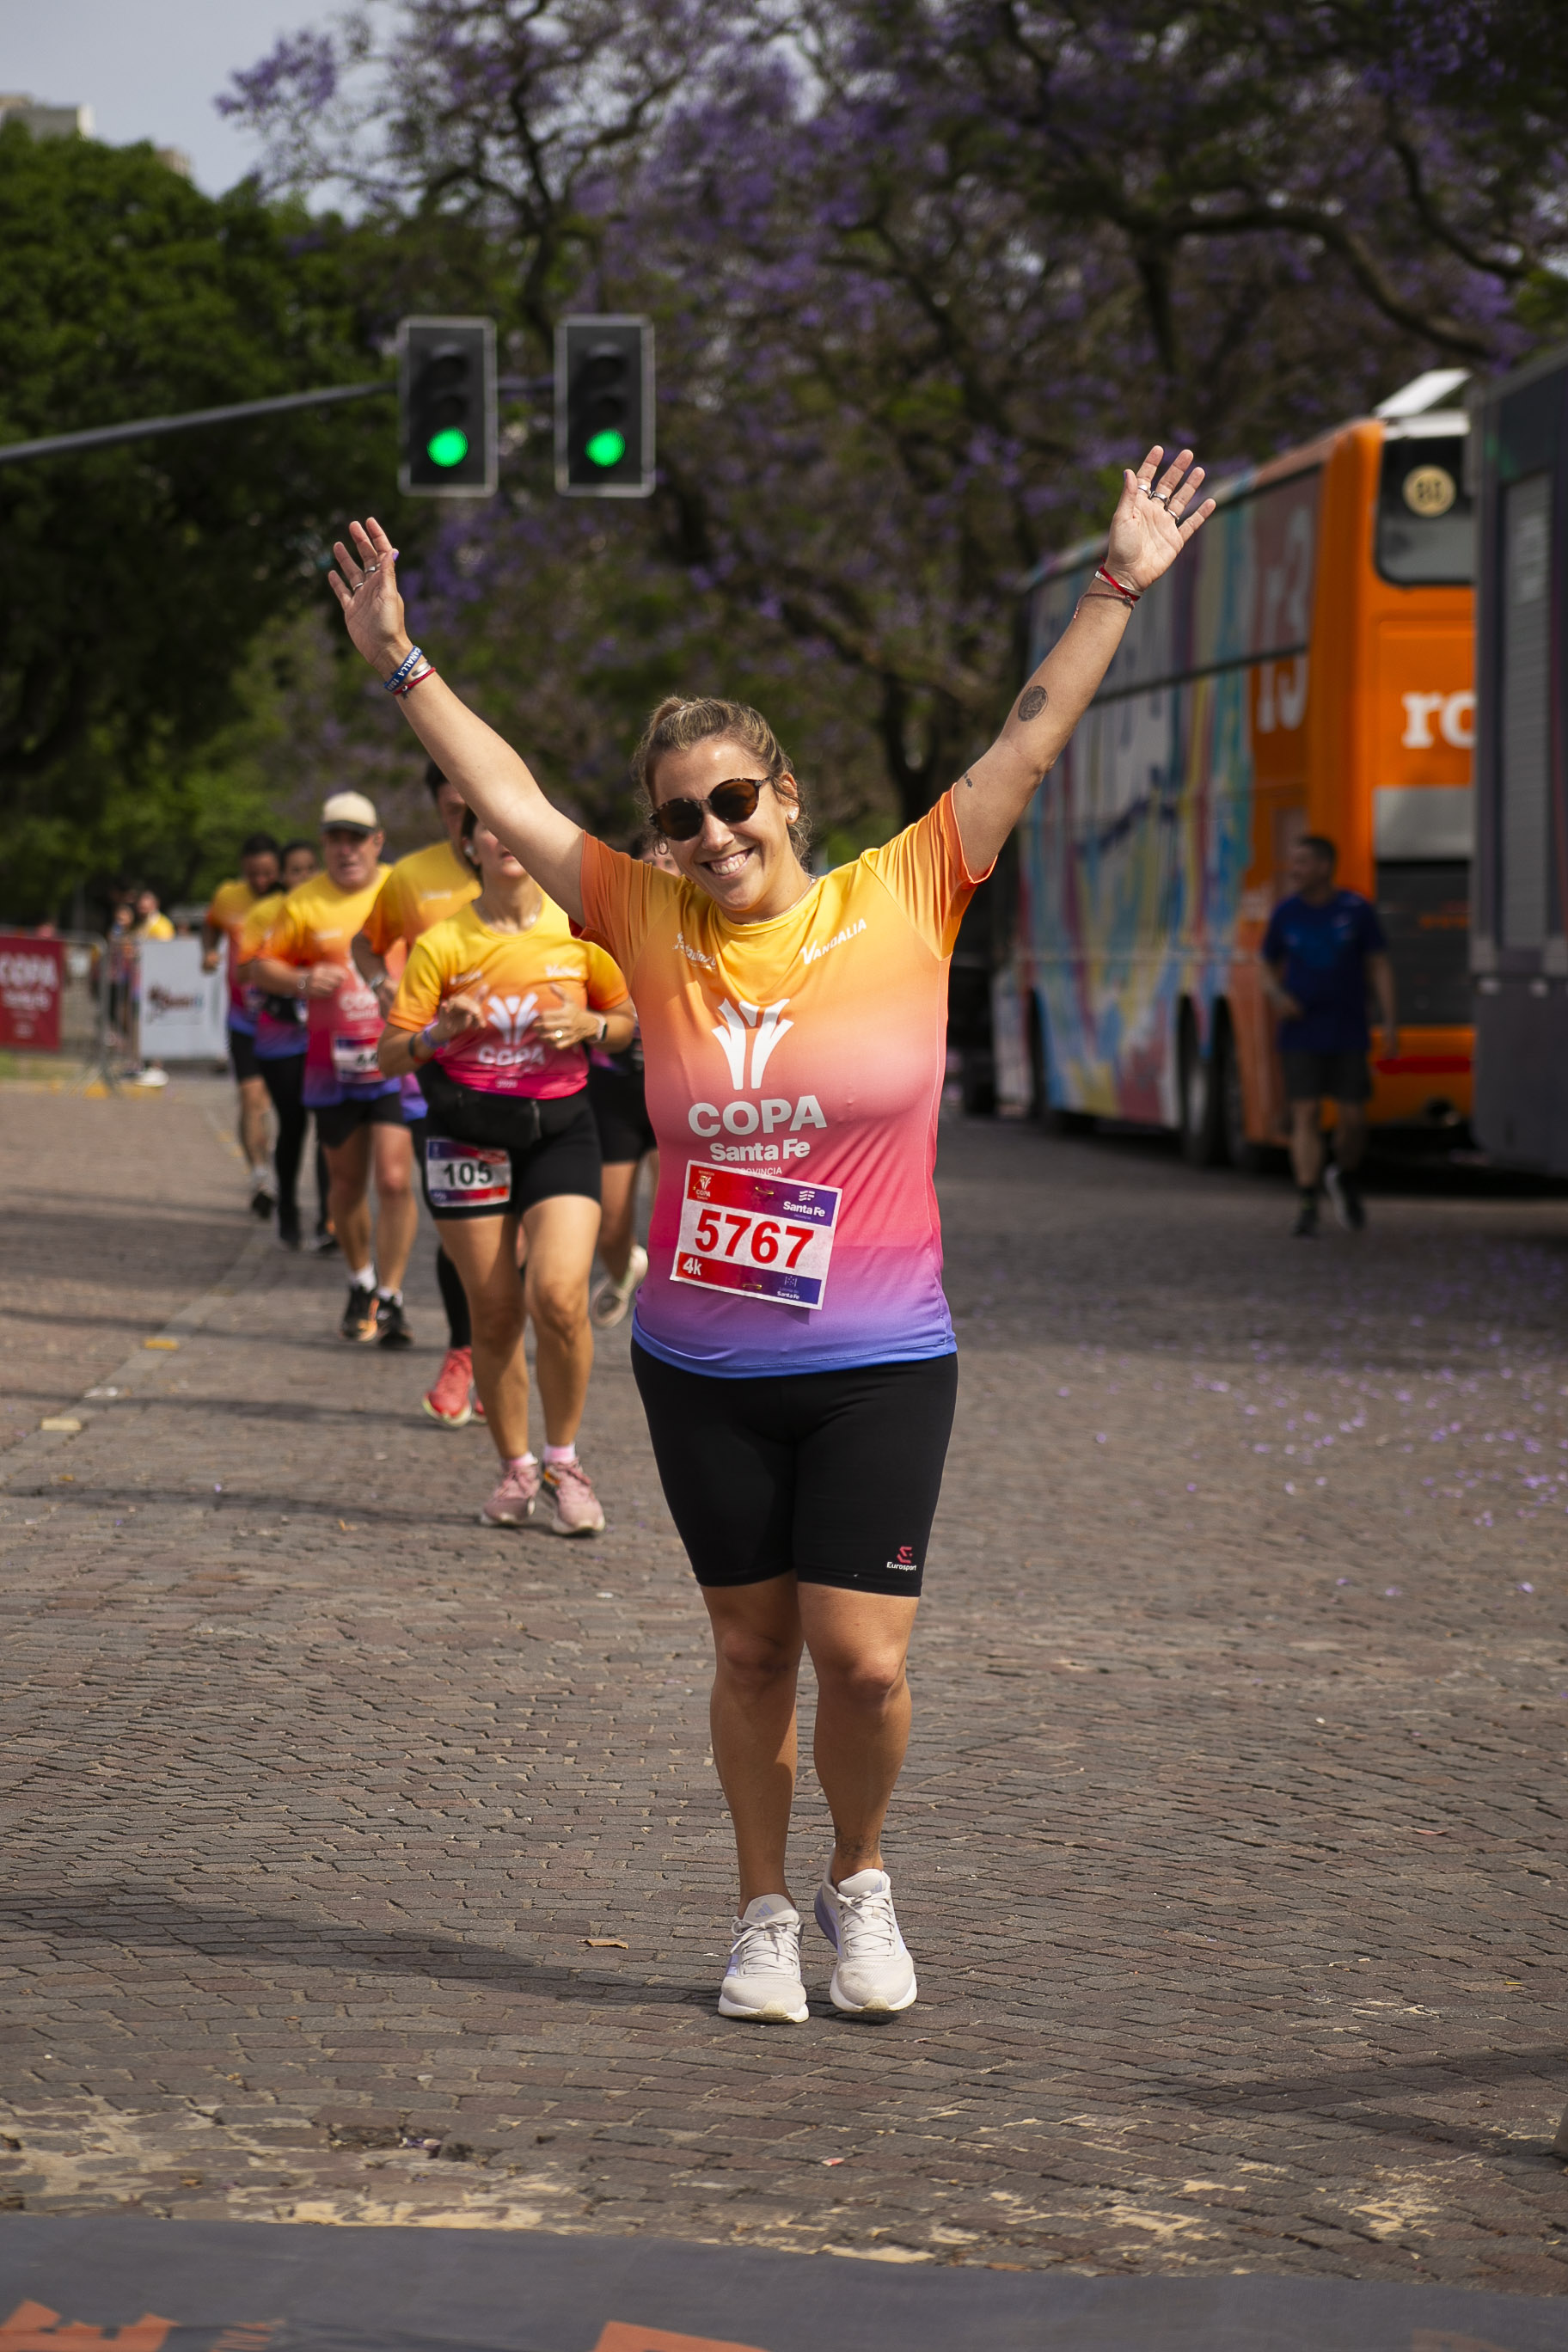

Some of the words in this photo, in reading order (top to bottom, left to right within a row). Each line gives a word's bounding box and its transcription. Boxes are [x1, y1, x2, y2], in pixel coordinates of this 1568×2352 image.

[689, 1095, 827, 1137] COPA
[710, 1142, 779, 1161] Santa
[783, 1138, 811, 1159] Fe
[444, 1161, 493, 1186] 105
[783, 1201, 812, 1215] Santa
[813, 1206, 825, 1217] Fe
[695, 1209, 815, 1269] 5767
[683, 1257, 702, 1276] 4k
[886, 1561, 917, 1571] Eurosport
